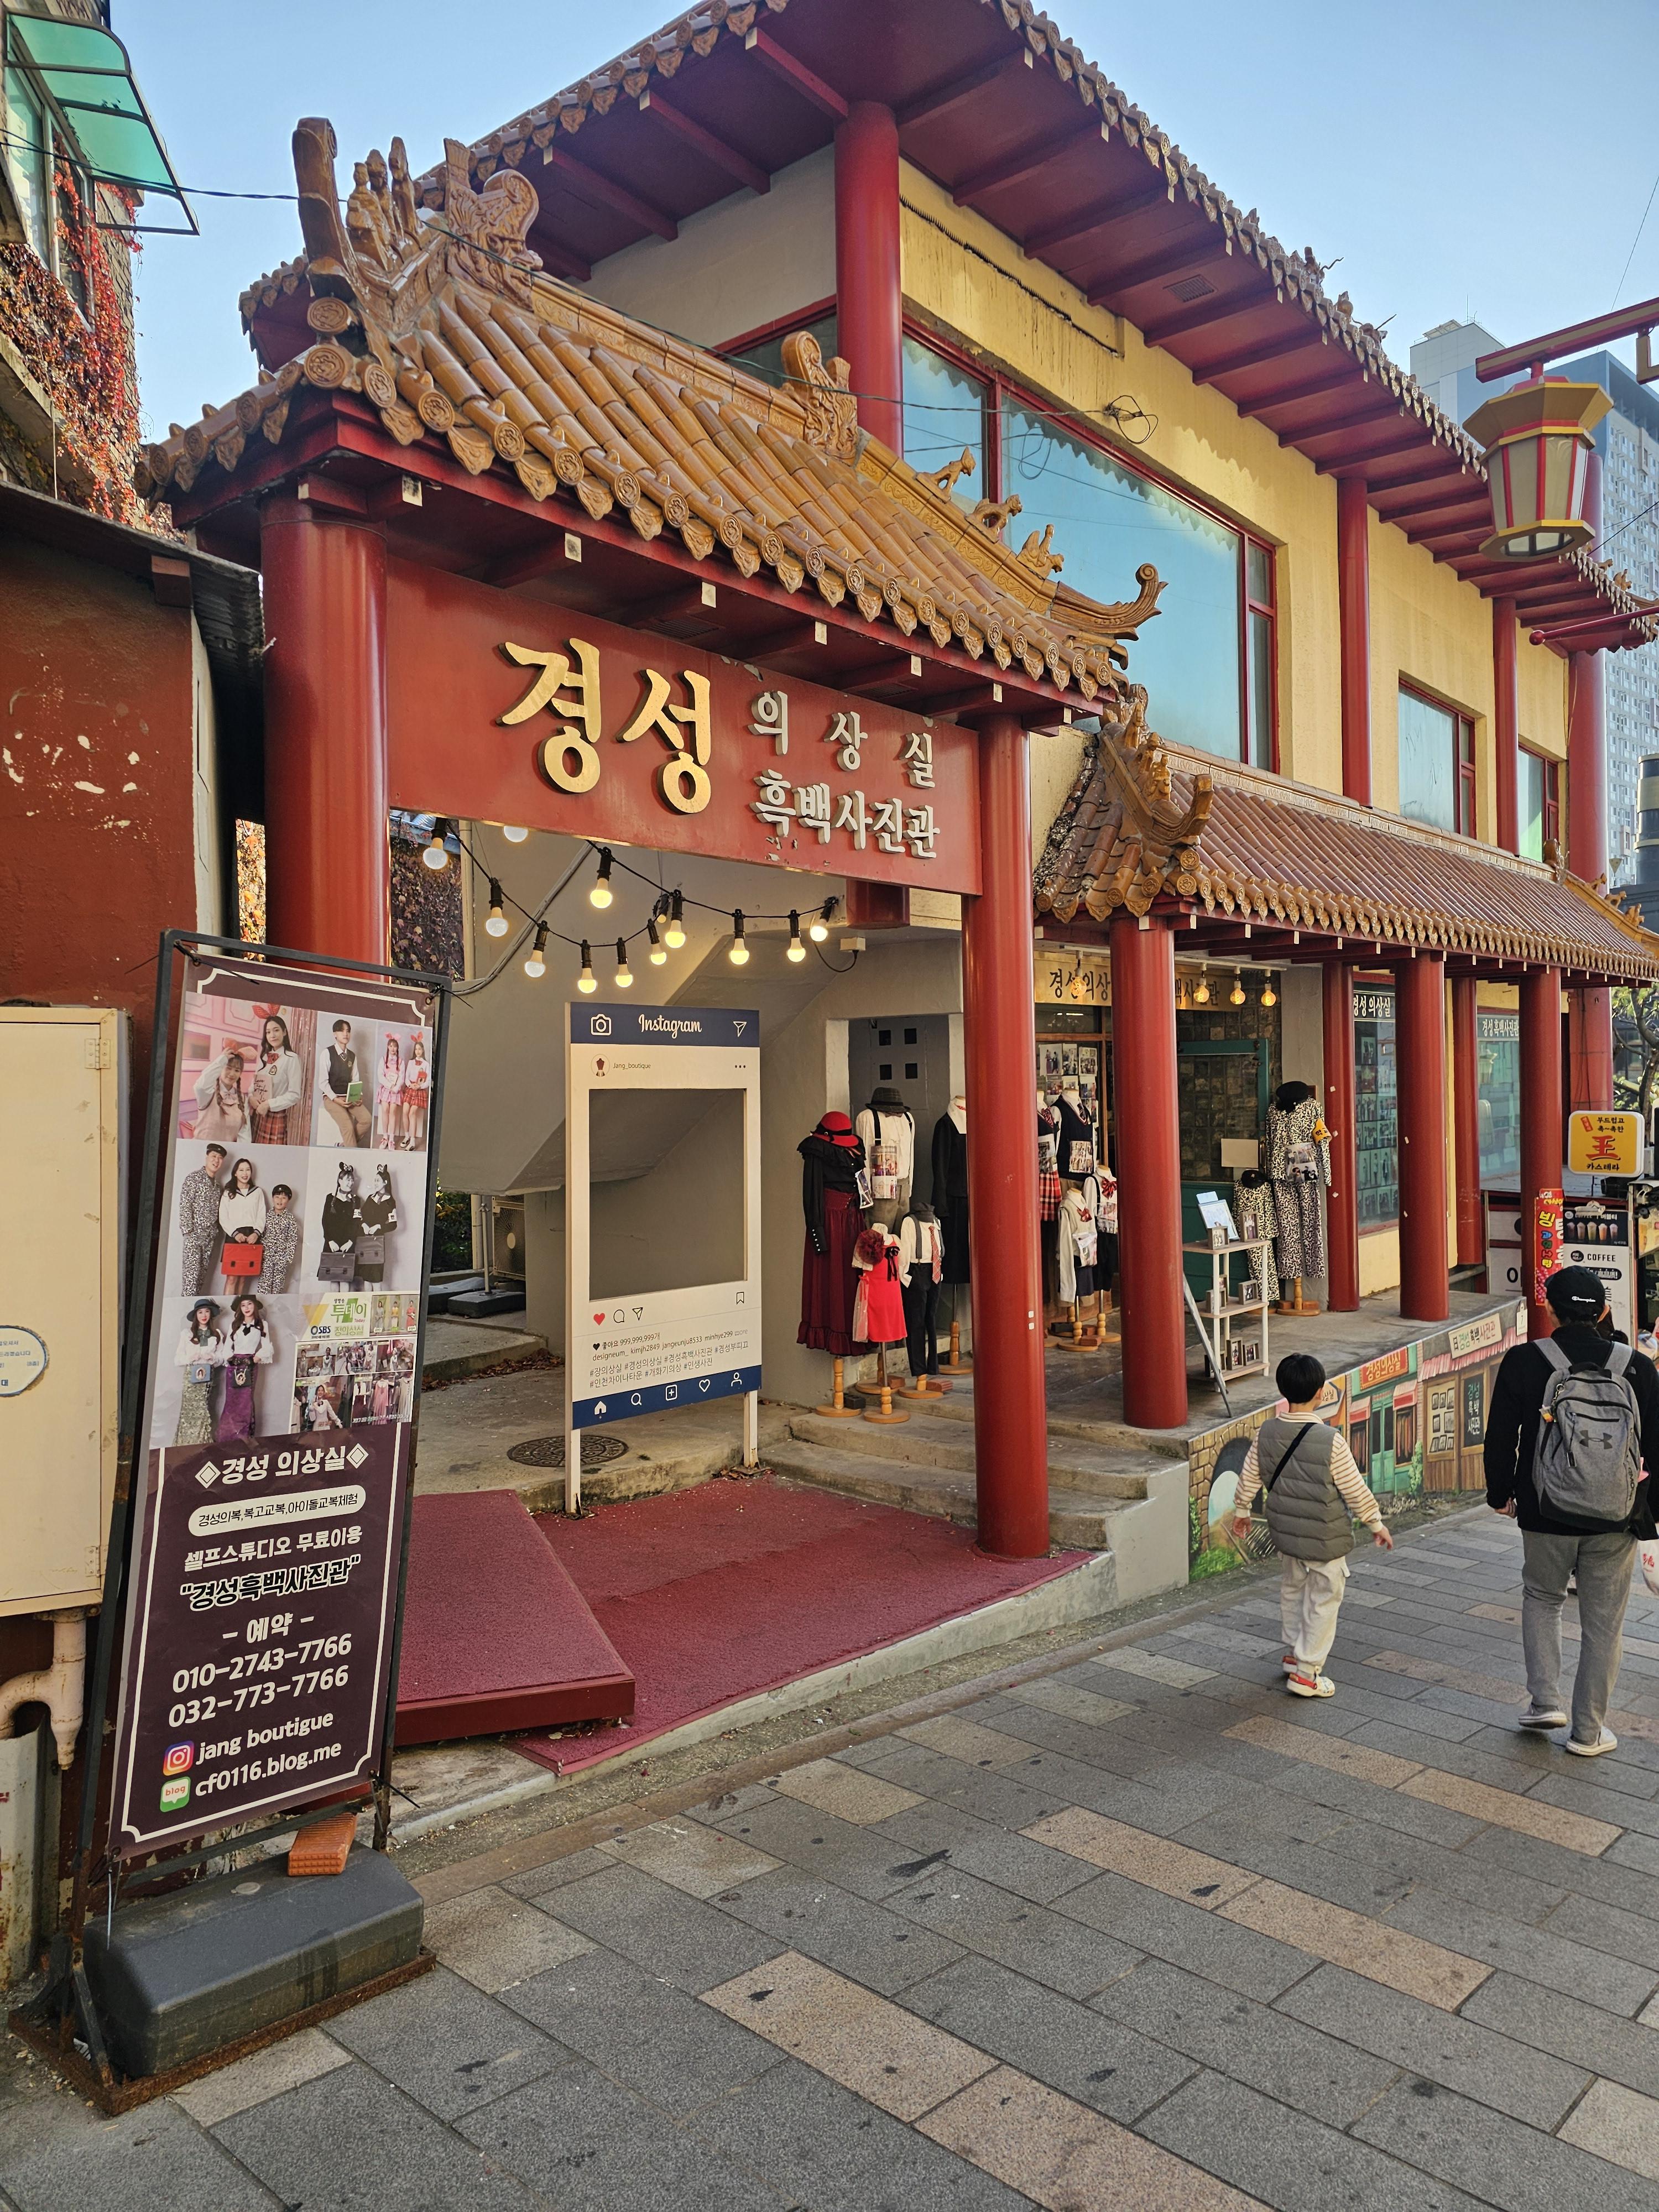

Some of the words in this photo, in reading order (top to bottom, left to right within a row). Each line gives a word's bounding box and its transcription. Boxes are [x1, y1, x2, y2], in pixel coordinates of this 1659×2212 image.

[497, 637, 712, 814] 경성
[750, 768, 941, 859] 흑백사진관
[1369, 995, 1391, 1018] 의상실
[638, 1014, 702, 1039] Instagram
[1585, 1135, 1621, 1161] 王
[1587, 1162, 1619, 1171] 카스테라
[1587, 1253, 1616, 1262] COFFEE
[331, 1303, 367, 1323] 투데이
[592, 1350, 629, 1361] designeum_
[630, 1343, 660, 1354] kimjh2849
[662, 1336, 702, 1350] jangeunju8533
[705, 1331, 733, 1341] minhye299
[602, 1340, 618, 1350] 좋아요
[590, 1363, 622, 1376] #장의상실
[624, 1356, 662, 1370] #경성의상실
[590, 1371, 642, 1388] #인천차이나타운
[645, 1364, 681, 1378] #개화기의상
[684, 1358, 712, 1370] #인생사진
[222, 1454, 269, 1484] 경성
[275, 1446, 346, 1477] 의상실
[184, 1537, 292, 1572] 셀프스튜디오
[296, 1525, 363, 1552] 무료이용
[247, 1612, 294, 1643] 예약
[173, 1634, 352, 1693] 010-2743-7766
[169, 1665, 349, 1727] 032-773-7766
[195, 1736, 242, 1765] jang
[247, 1713, 333, 1748] boutigue
[195, 1743, 342, 1796] cf0116.blog.me
[165, 1785, 186, 1796] blog
